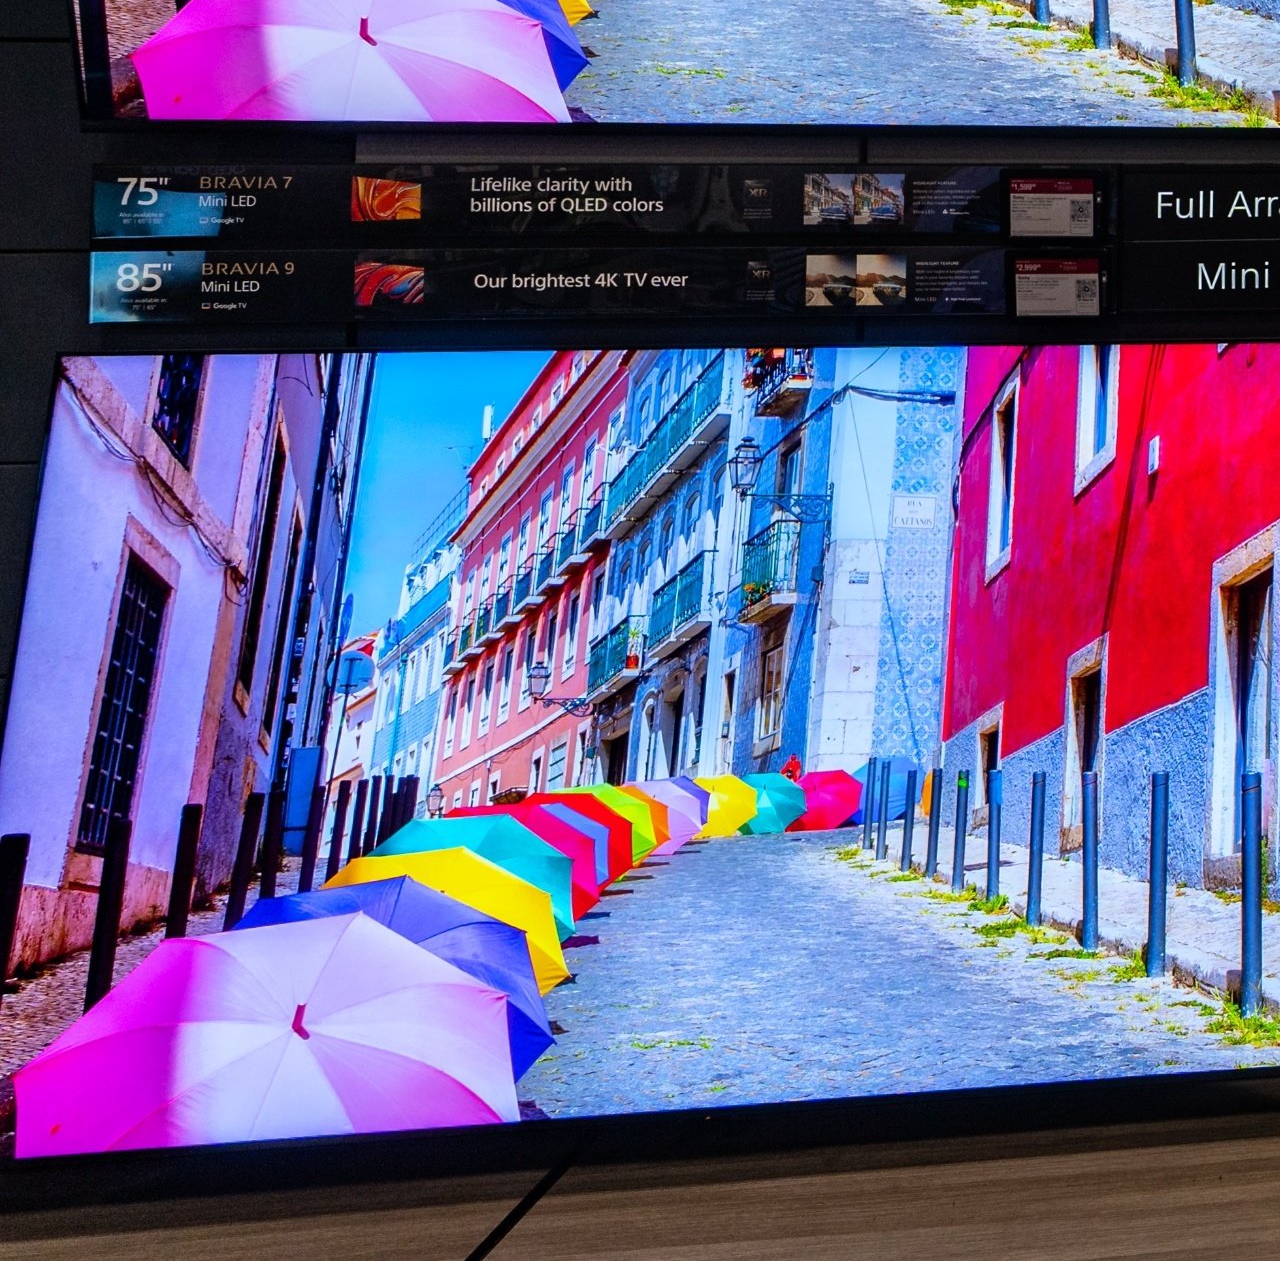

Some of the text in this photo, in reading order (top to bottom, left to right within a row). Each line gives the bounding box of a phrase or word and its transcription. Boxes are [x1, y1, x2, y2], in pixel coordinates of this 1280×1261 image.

[200, 176, 293, 189] BRAVIA 7
[471, 177, 632, 195] Lifelike clarity with
[117, 177, 169, 206] 75"
[199, 195, 257, 207] Mini LED
[470, 197, 664, 214] billions of QLED colors
[1157, 190, 1214, 219] Full
[210, 216, 235, 225] Google
[202, 262, 295, 275] BRAVIA 9
[1198, 261, 1269, 290] Mini
[115, 263, 172, 292] 85"
[474, 273, 688, 291] Our brightest 4K TV ever
[201, 280, 260, 293] Mini LED
[213, 302, 237, 310] Google
